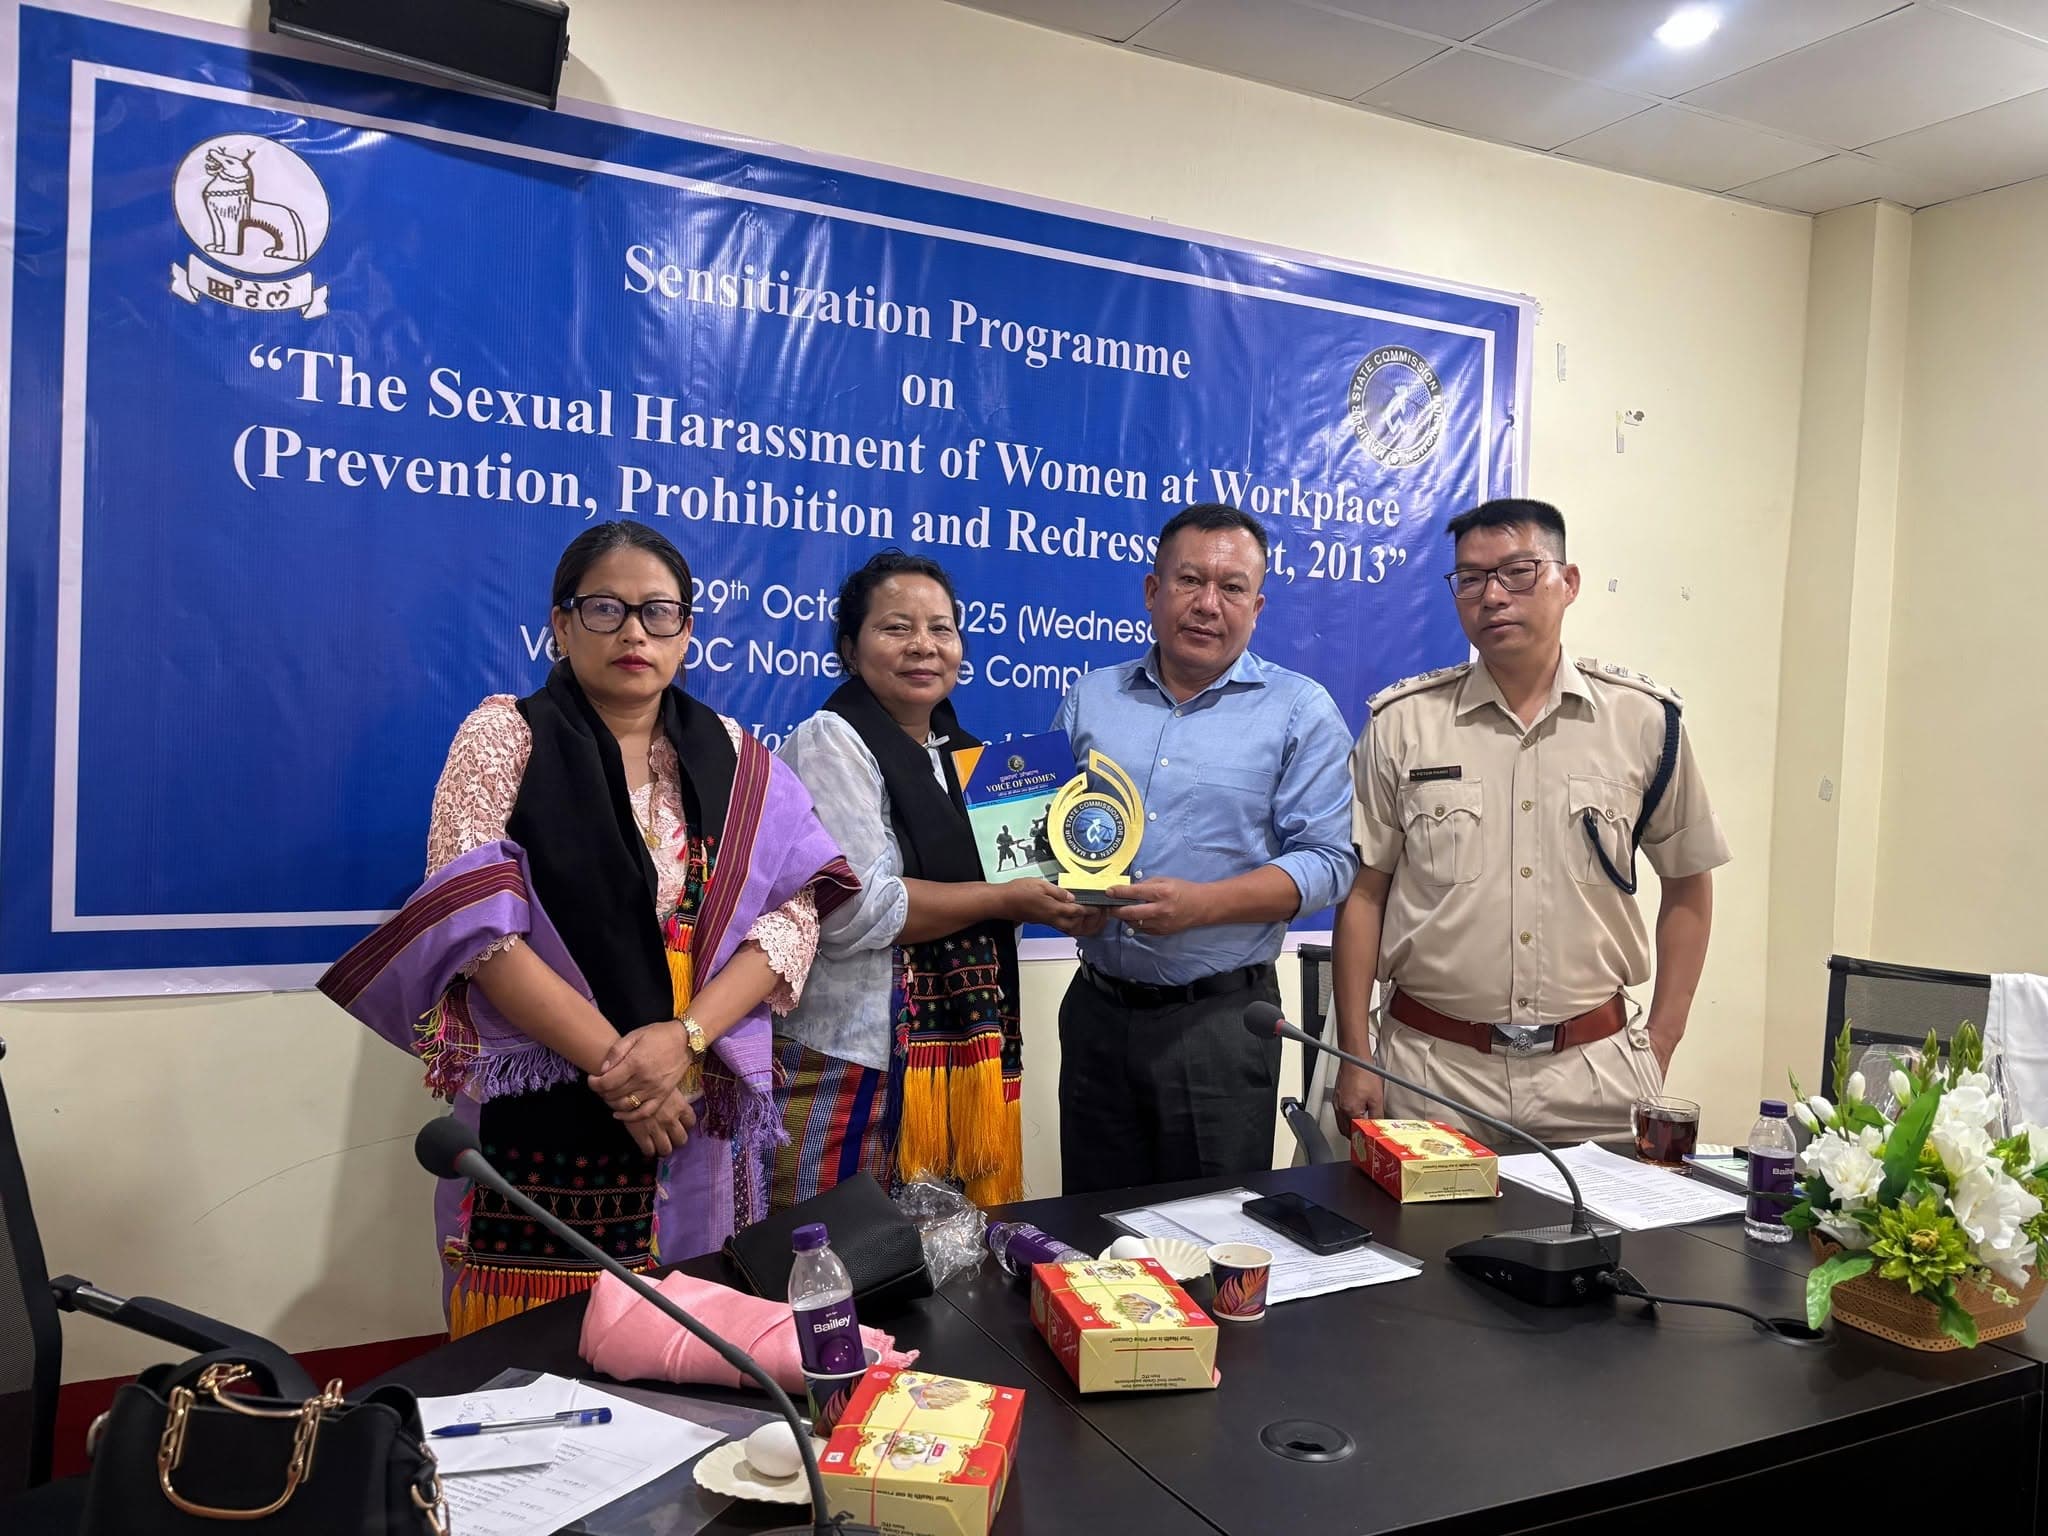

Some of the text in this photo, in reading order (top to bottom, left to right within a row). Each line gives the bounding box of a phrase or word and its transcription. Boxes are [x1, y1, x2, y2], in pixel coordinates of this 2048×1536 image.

[624, 244, 1191, 379] Sensitization Programme
[902, 374, 955, 410] on
[1352, 361, 1374, 401] STATE
[1374, 350, 1437, 390] COMMISSION
[250, 343, 1400, 530] “The Sexual Harassment of Women at Workplace
[233, 424, 598, 520] (Prevention,
[616, 465, 895, 541] Prohibition
[911, 505, 991, 548] and
[1006, 509, 1159, 564] Redress
[1306, 540, 1407, 585] 2013”
[762, 584, 841, 623] Octo
[956, 599, 1007, 634] 025
[1018, 605, 1157, 644] (Wednes
[748, 640, 842, 678] None
[986, 655, 1089, 696] Comp
[986, 781, 1012, 793] VOICE
[1012, 779, 1024, 788] OF
[1024, 772, 1057, 785] WOMEN
[1066, 808, 1080, 828] STATE
[1080, 801, 1120, 820] COMMISSION
[1065, 830, 1086, 857] MANIPUR
[1100, 837, 1121, 858] WOMEN
[813, 1314, 851, 1333] Bailley
